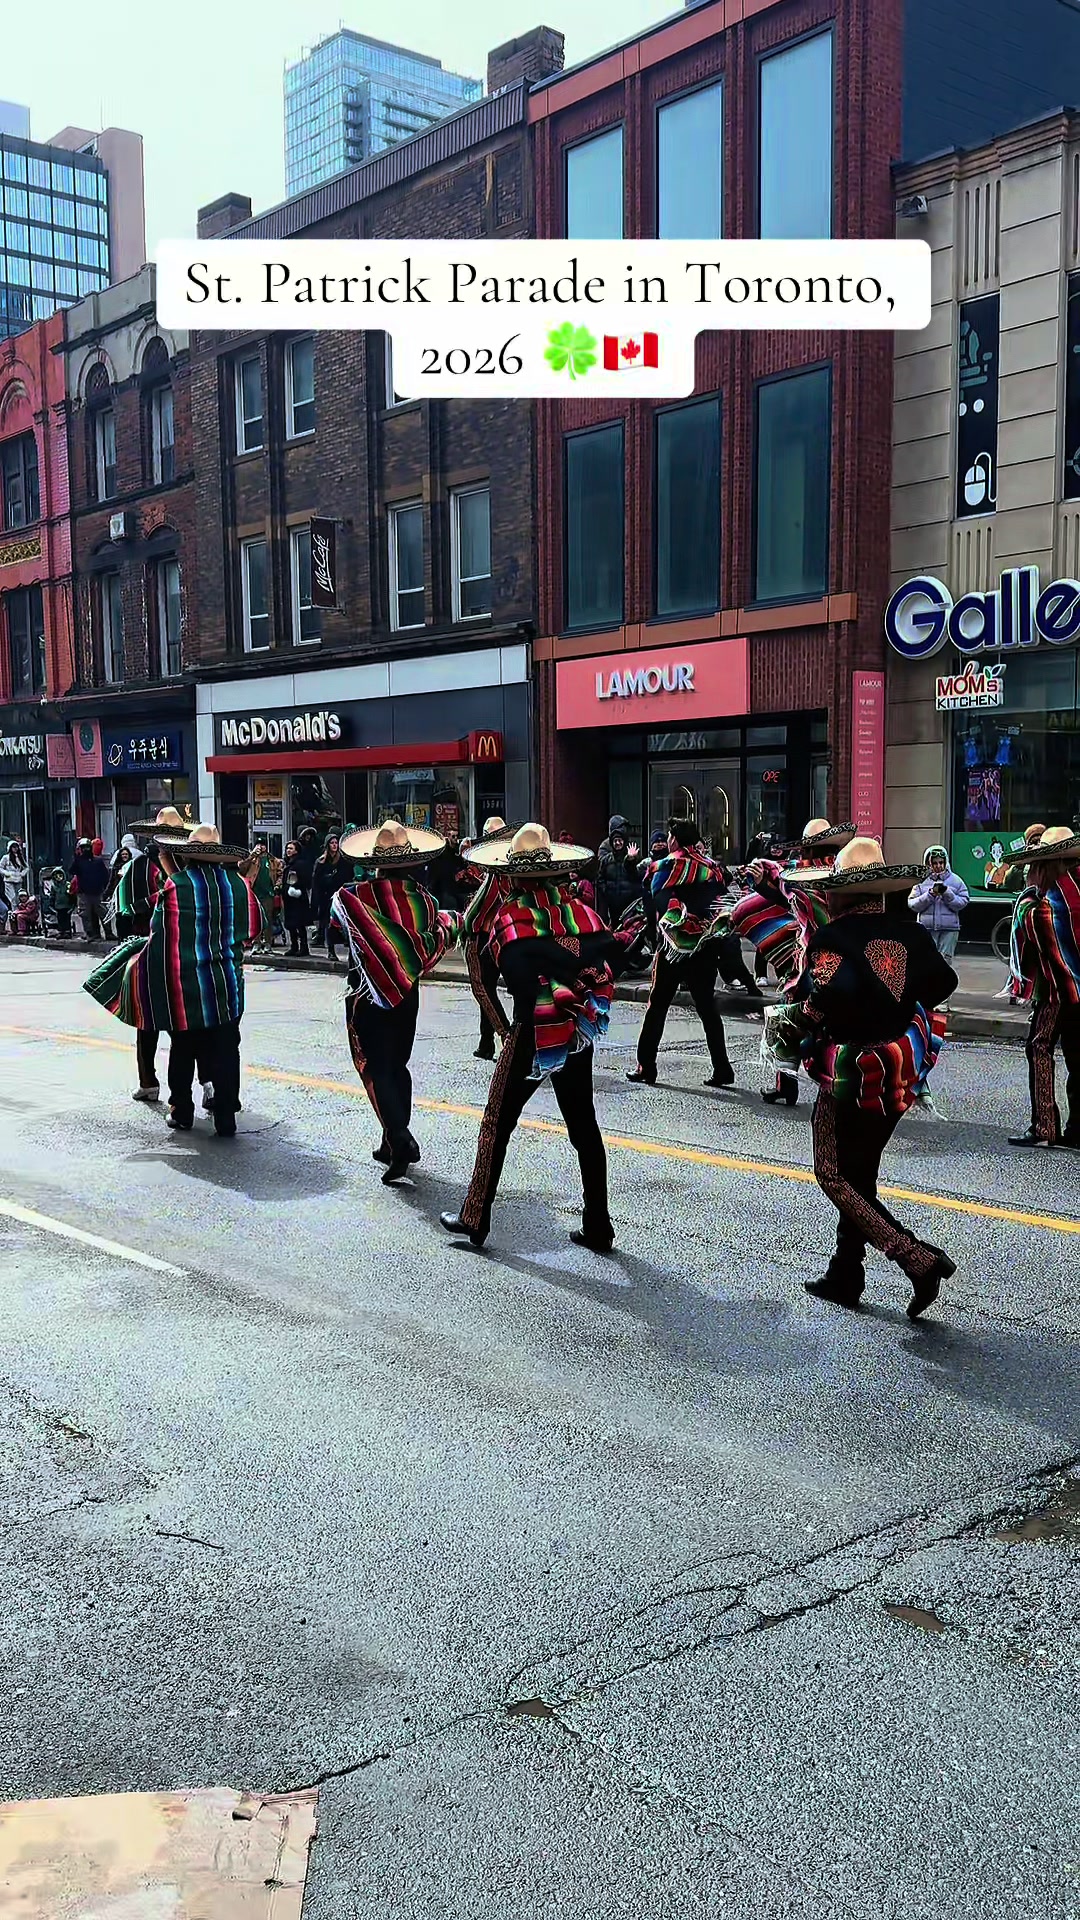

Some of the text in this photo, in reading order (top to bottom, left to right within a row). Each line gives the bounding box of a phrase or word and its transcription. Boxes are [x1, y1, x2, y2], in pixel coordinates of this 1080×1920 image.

[884, 565, 1080, 660] Galle
[595, 662, 695, 700] LAMOUR
[937, 693, 998, 710] KITCHEN
[221, 711, 341, 747] McDonald's
[128, 736, 169, 761] 우주분식
